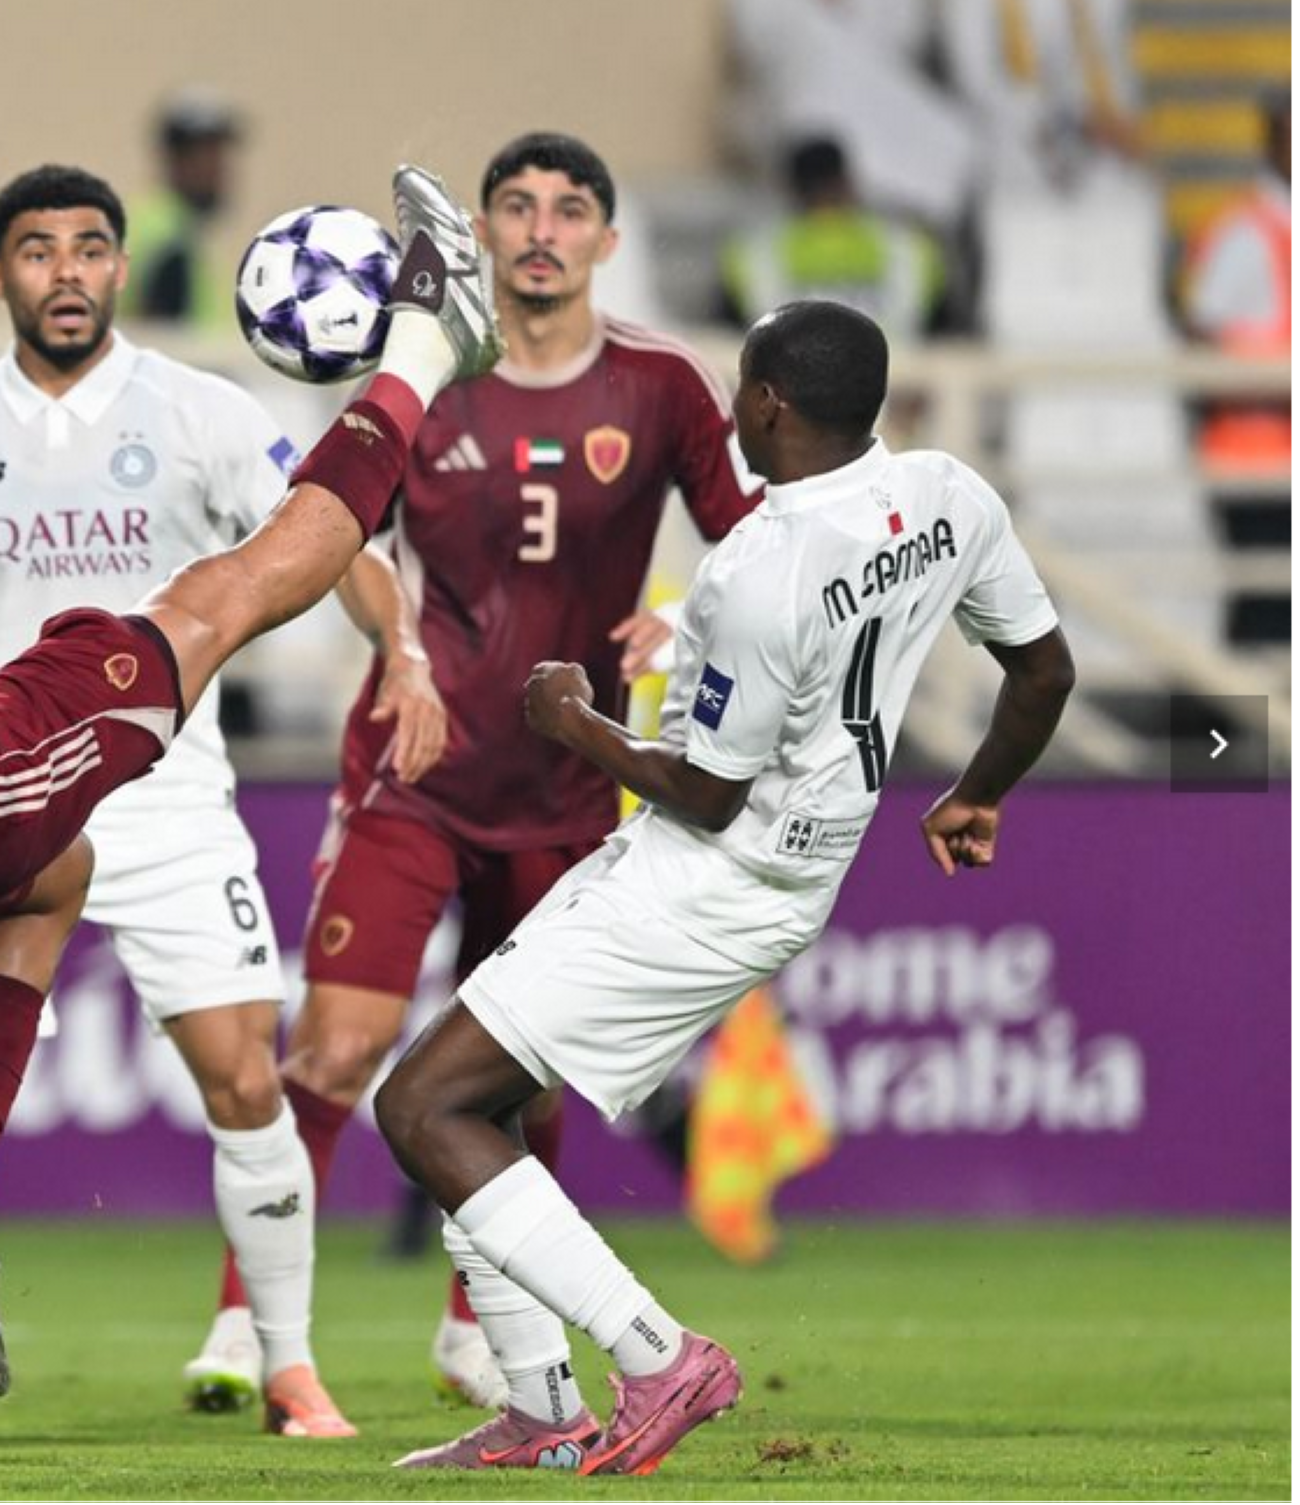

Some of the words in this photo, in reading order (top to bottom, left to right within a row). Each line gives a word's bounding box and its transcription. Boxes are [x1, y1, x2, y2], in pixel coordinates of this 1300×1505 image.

[518, 483, 558, 562] 3
[25, 550, 152, 580] AIRWAYS
[223, 876, 258, 932] 6
[778, 922, 1055, 1028] ome
